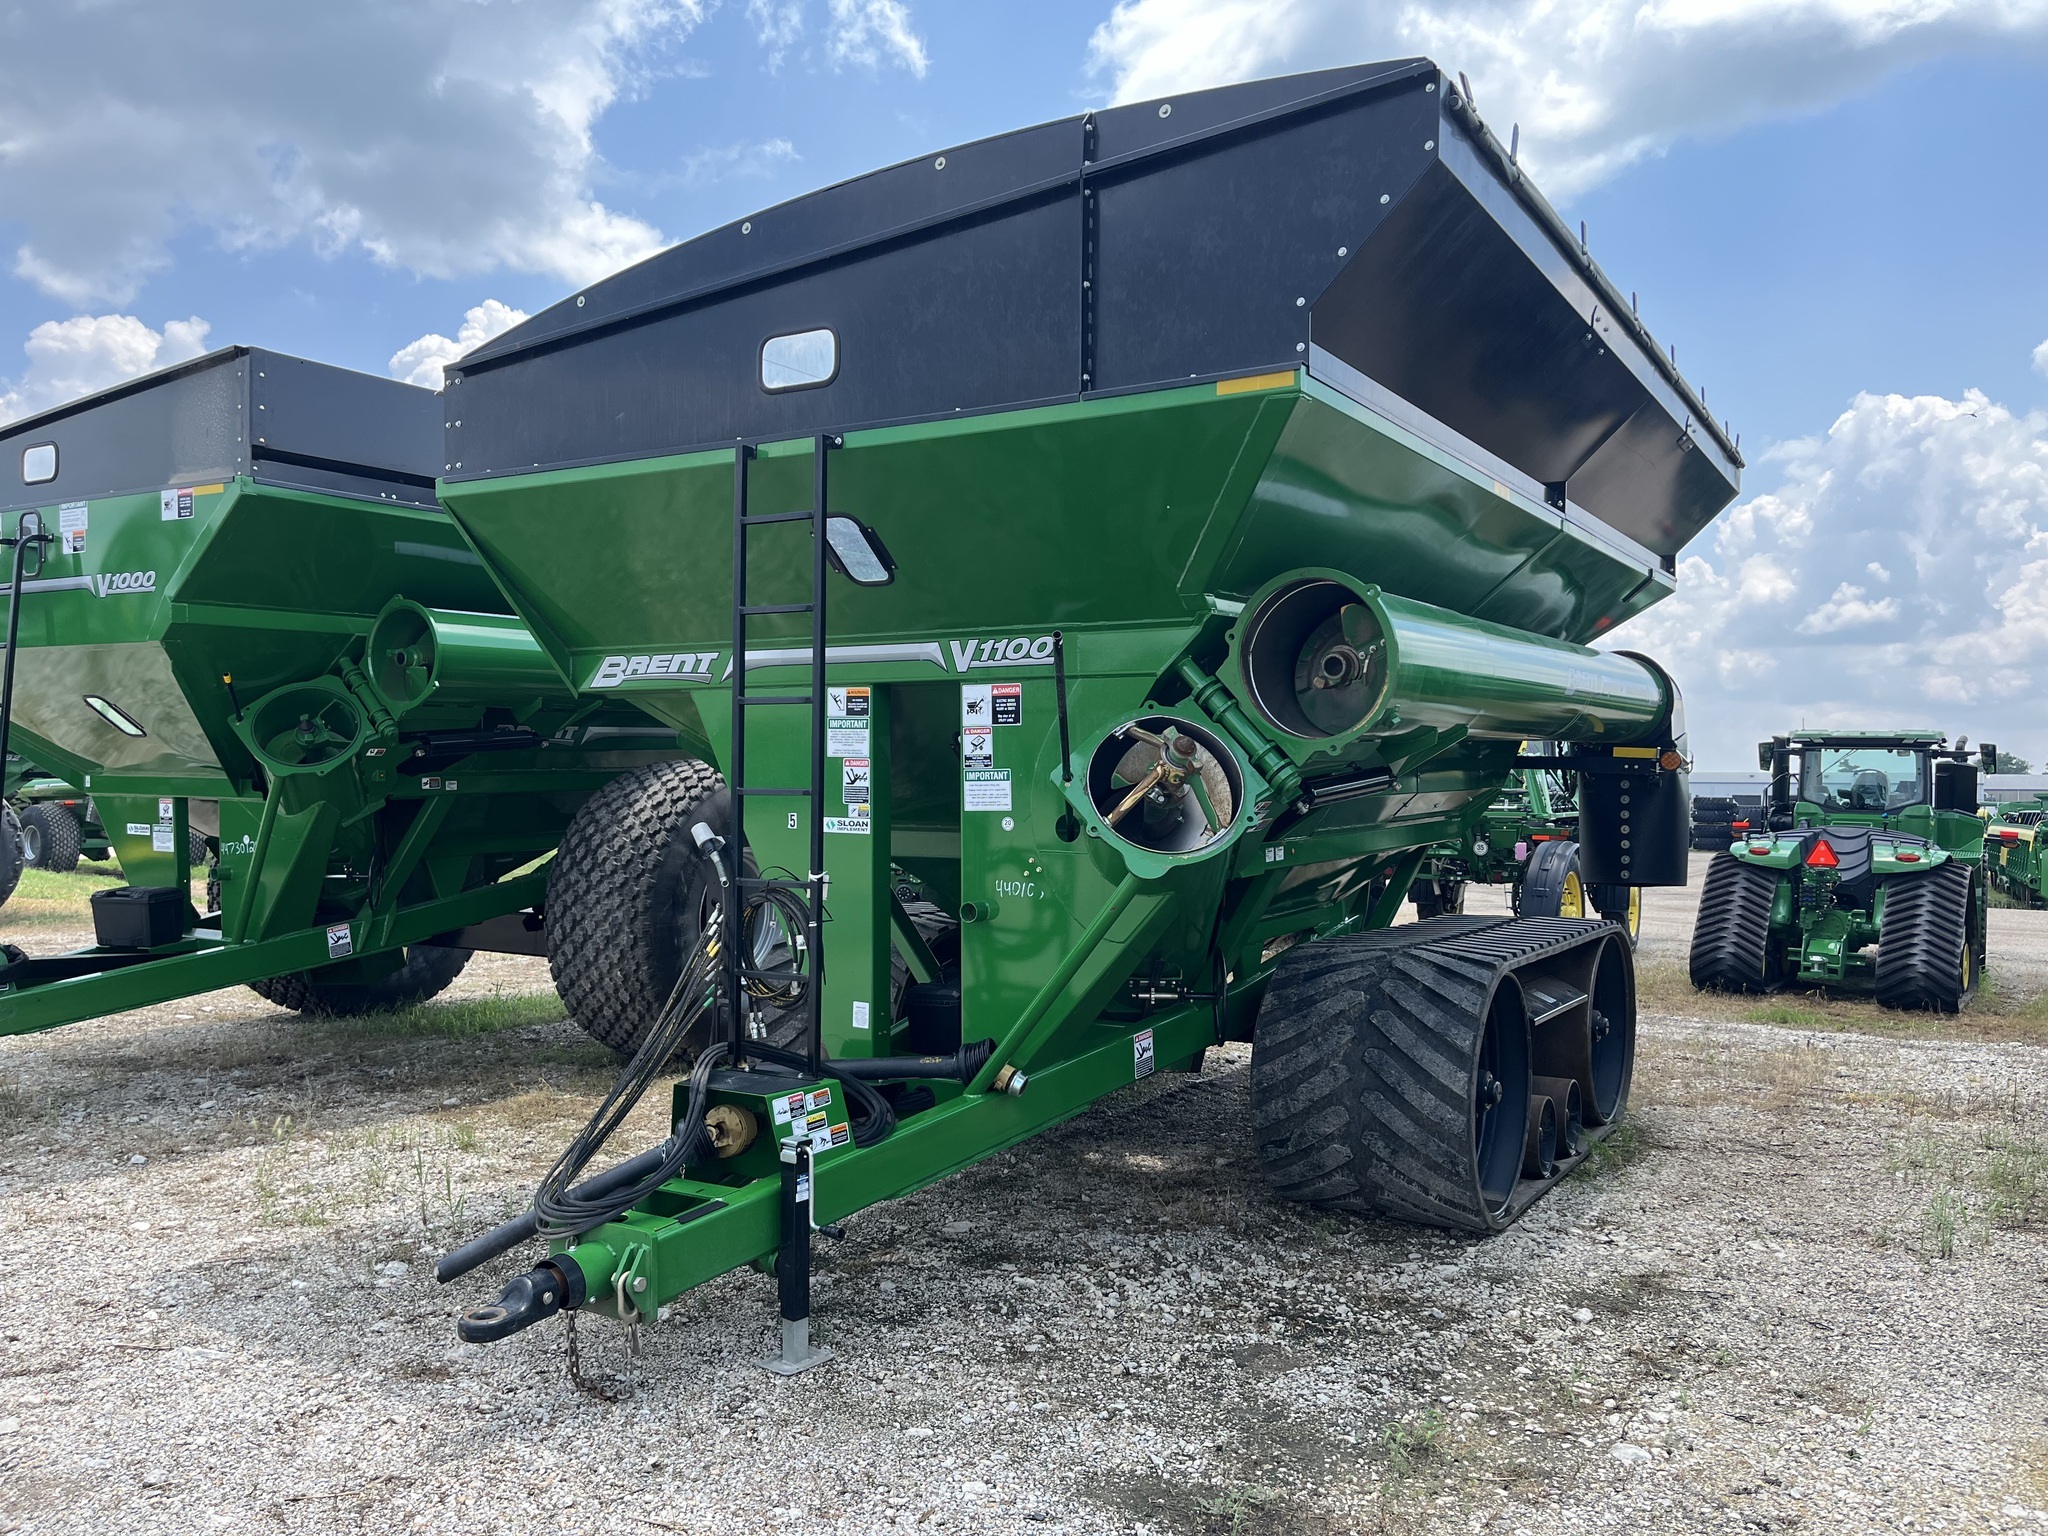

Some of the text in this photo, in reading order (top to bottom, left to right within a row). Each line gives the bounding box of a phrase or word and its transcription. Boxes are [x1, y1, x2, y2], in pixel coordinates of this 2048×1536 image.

[96, 571, 156, 598] V1000
[949, 636, 1055, 673] V1100
[590, 652, 720, 688] BRENT
[829, 720, 868, 729] IMPORTANT
[966, 771, 1008, 781] IMPORTANT
[790, 814, 796, 828] 5
[837, 820, 869, 828] SLOAN
